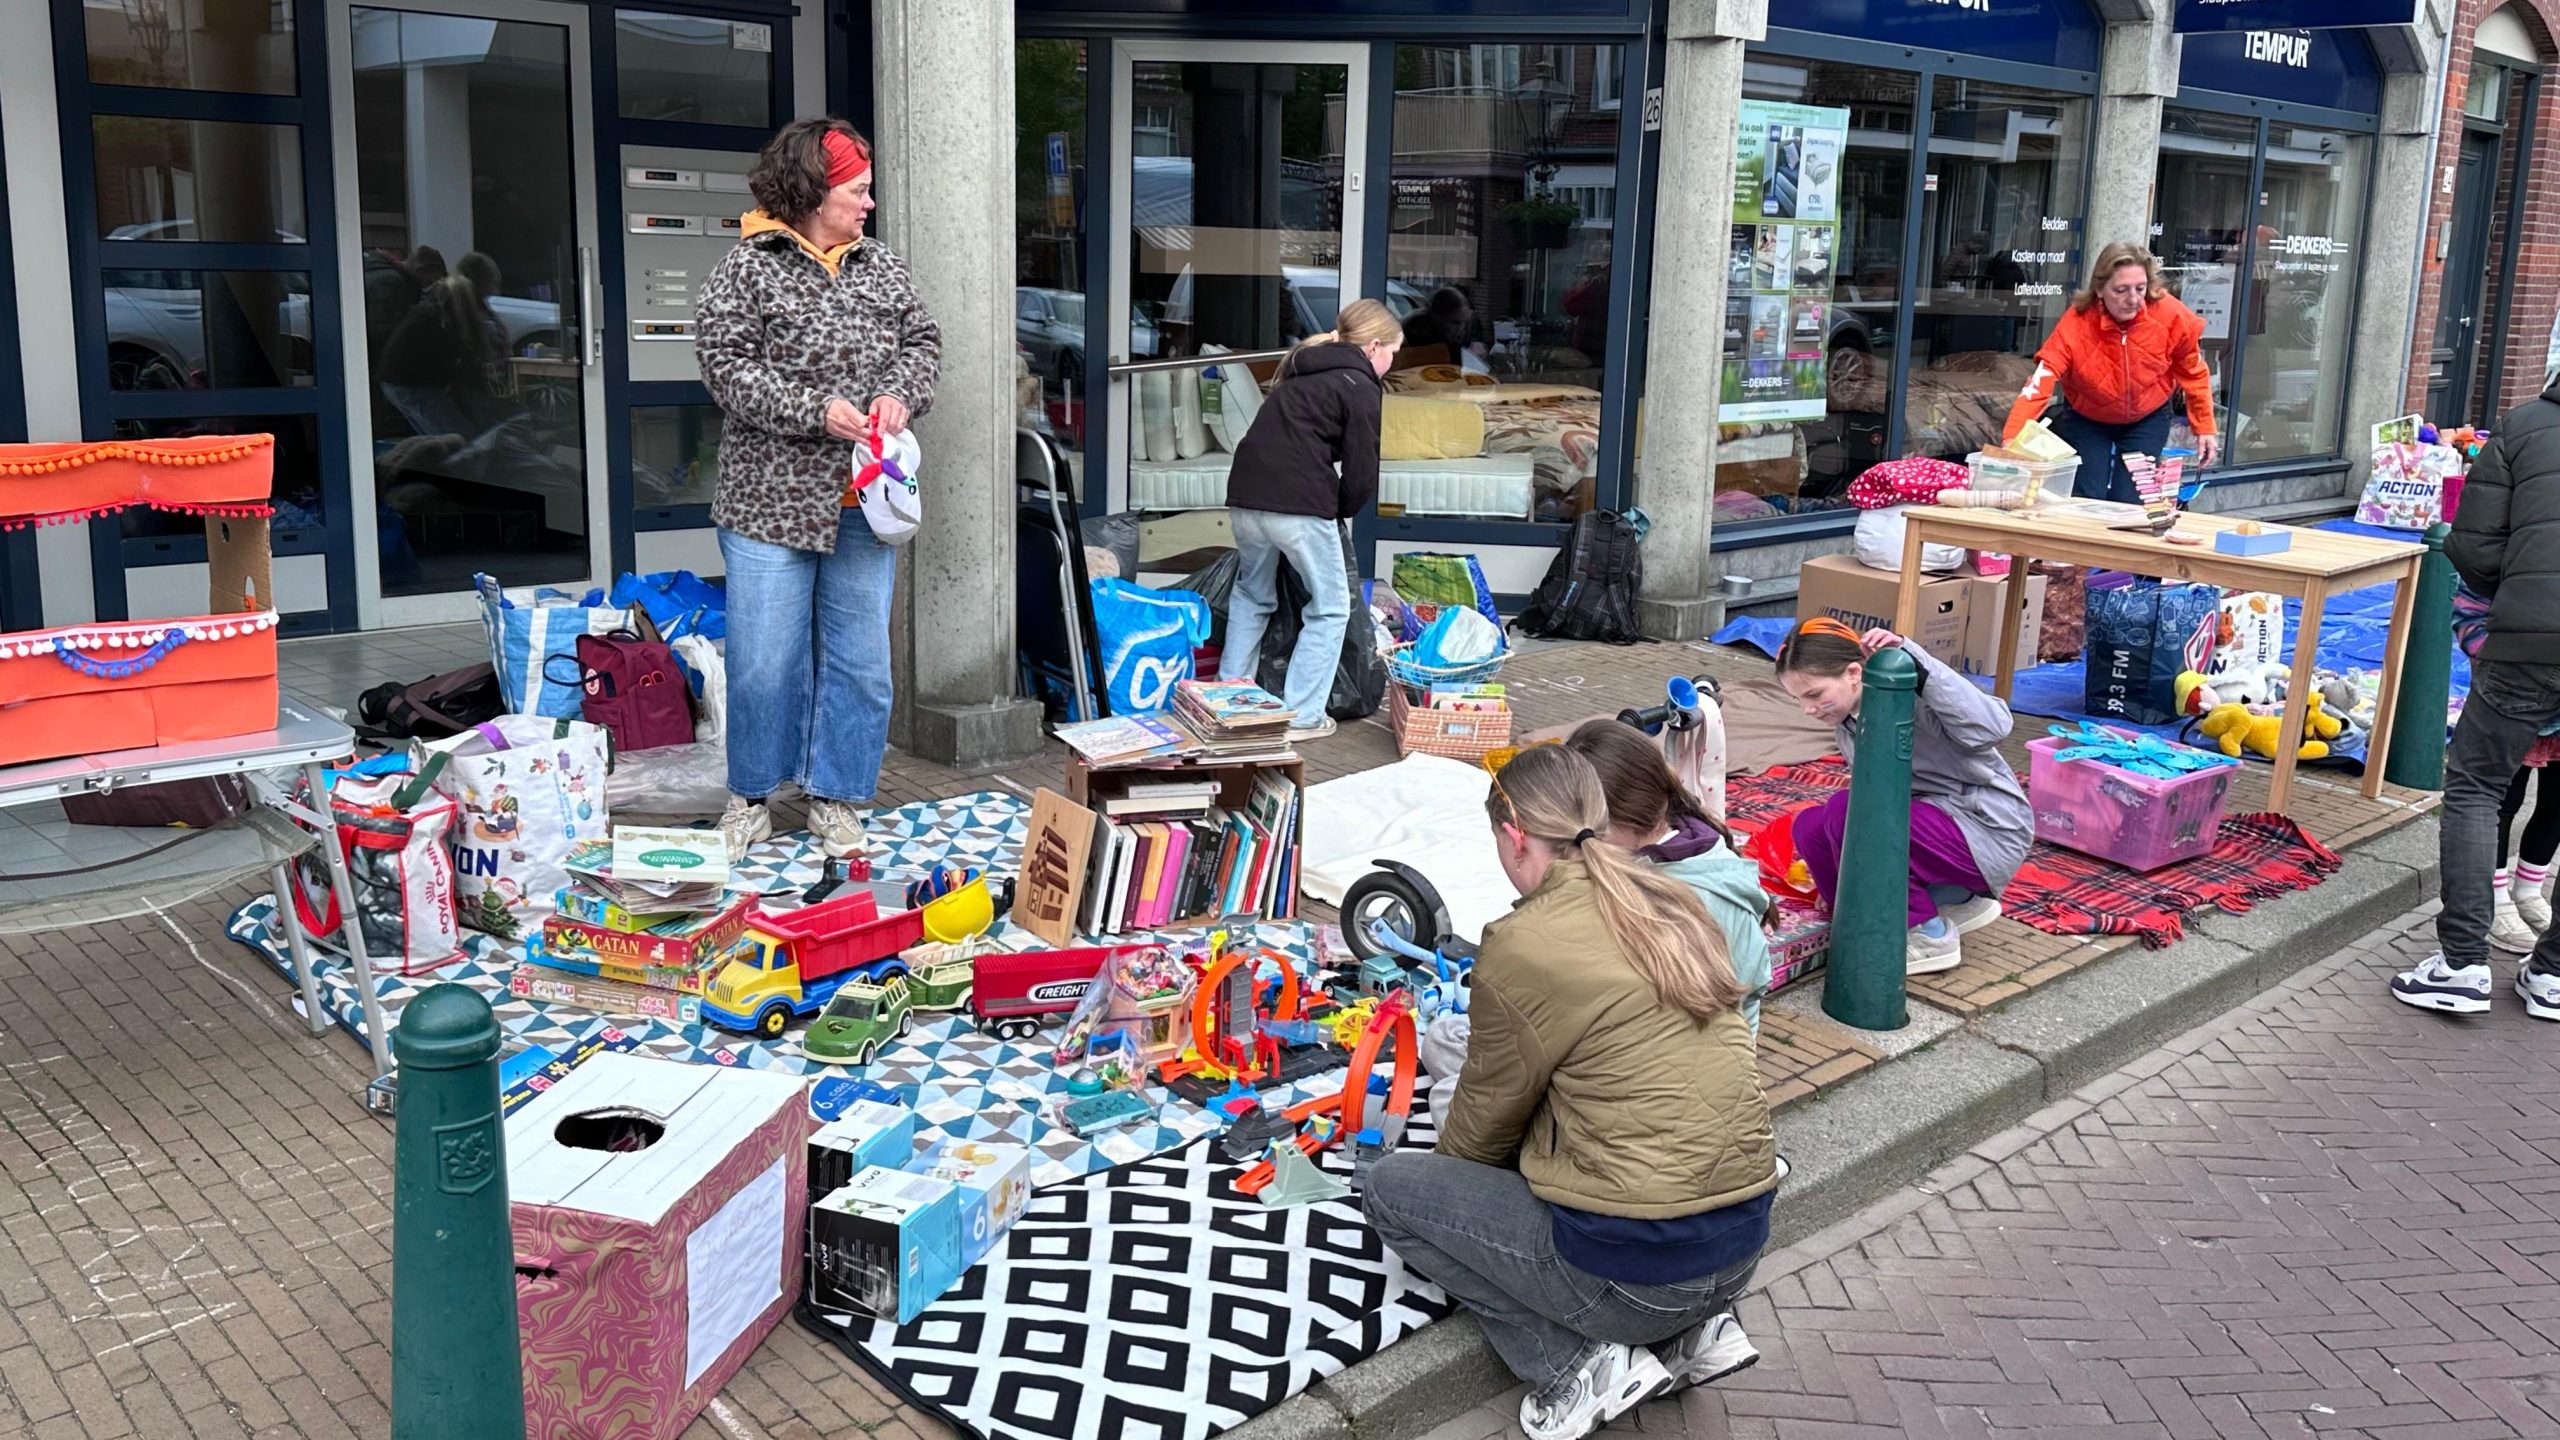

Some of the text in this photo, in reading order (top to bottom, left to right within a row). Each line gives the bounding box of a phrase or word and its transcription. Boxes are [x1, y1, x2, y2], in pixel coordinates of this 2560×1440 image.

[2245, 31, 2309, 68] TEMPUR
[1647, 95, 1660, 124] 26
[2042, 217, 2068, 230] Bedden
[2286, 235, 2332, 255] DEKKERS
[2012, 250, 2066, 266] Kasten op maat
[1749, 376, 1783, 388] DEKKERS
[2379, 480, 2437, 497] ACTION
[2258, 620, 2267, 663] ACTION
[2112, 650, 2130, 679] FM
[714, 916, 738, 943] CATAN
[592, 934, 640, 956] CATAN
[972, 1206, 987, 1241] 6
